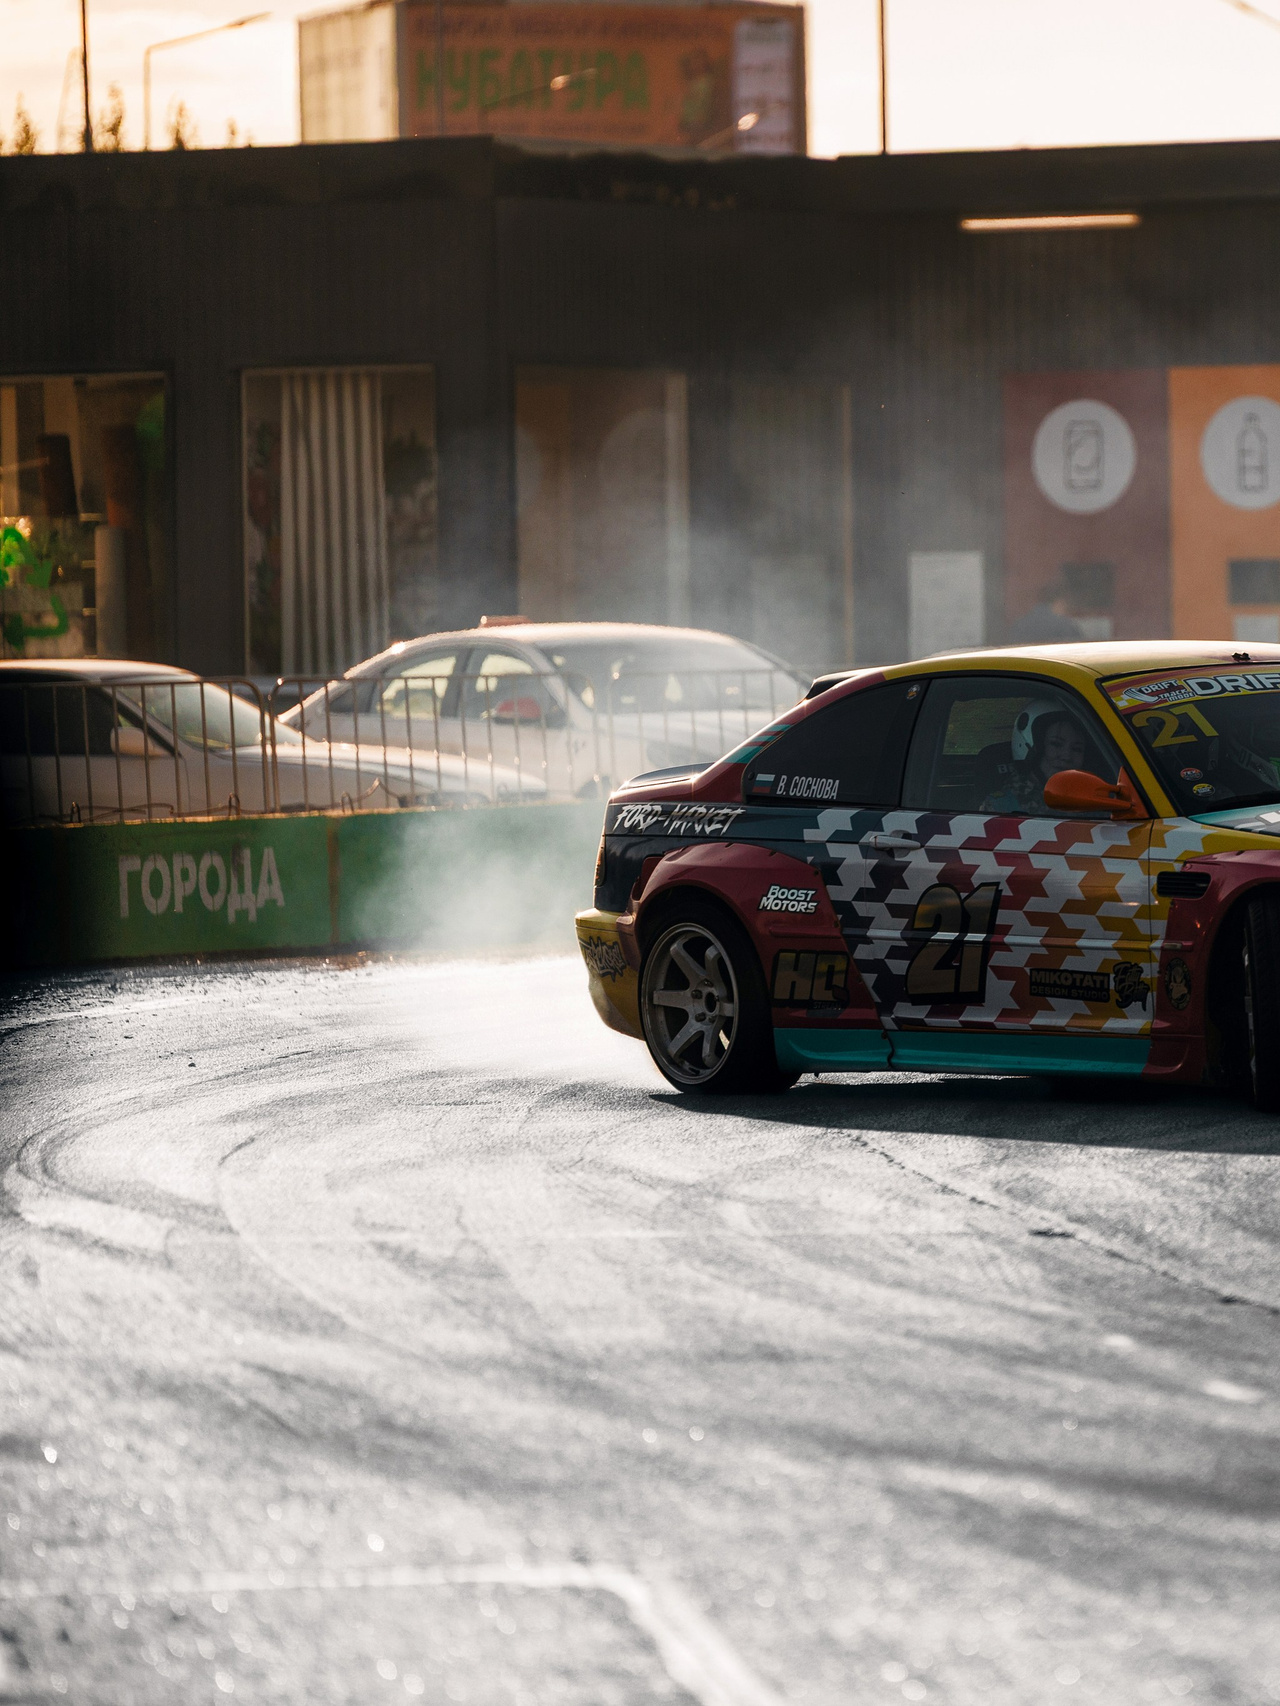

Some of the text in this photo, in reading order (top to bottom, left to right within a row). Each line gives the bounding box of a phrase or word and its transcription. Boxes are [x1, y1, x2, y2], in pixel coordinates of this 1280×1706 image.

[1141, 679, 1178, 694] DRIFT
[1160, 688, 1188, 699] TRACK
[1131, 703, 1219, 748] 21
[777, 775, 840, 799] В. СОСНОВА
[612, 802, 746, 835] FORD-MARKET
[118, 847, 285, 924] ГОРОДА
[767, 885, 816, 900] BOOST
[759, 896, 818, 914] MOTORS
[906, 882, 1001, 1003] 21
[1031, 969, 1109, 989] MIKOTATI
[1031, 985, 1109, 1001] DESIGN STUDIO
